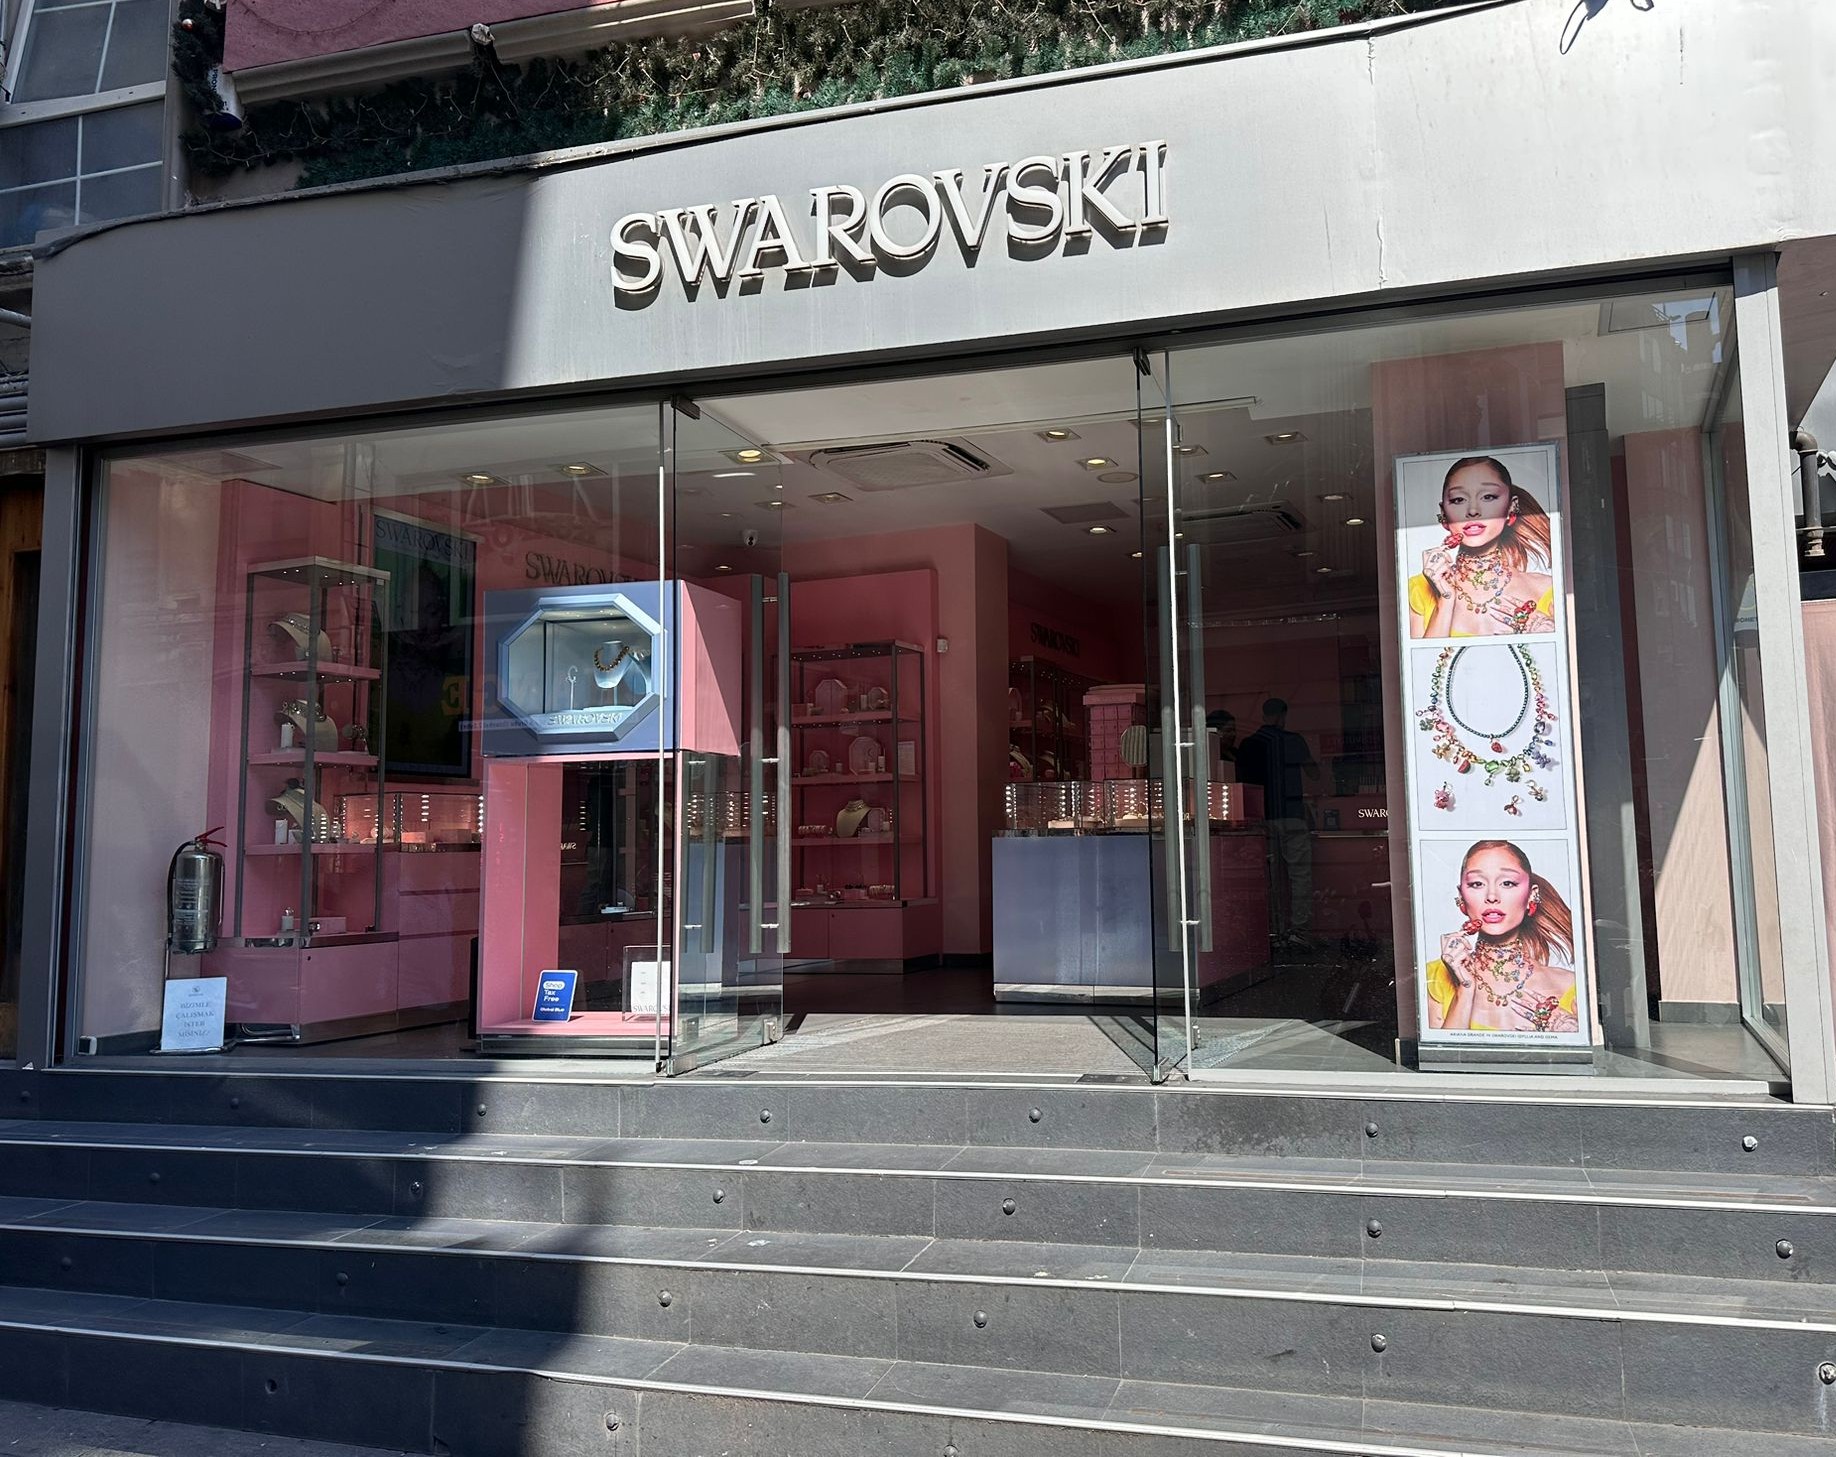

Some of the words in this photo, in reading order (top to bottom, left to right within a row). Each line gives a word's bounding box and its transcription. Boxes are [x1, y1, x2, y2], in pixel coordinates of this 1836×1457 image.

[609, 139, 1169, 293] SWAROVSKI
[375, 518, 468, 561] SWAROVSKI
[547, 712, 623, 726] SWAROVSKI
